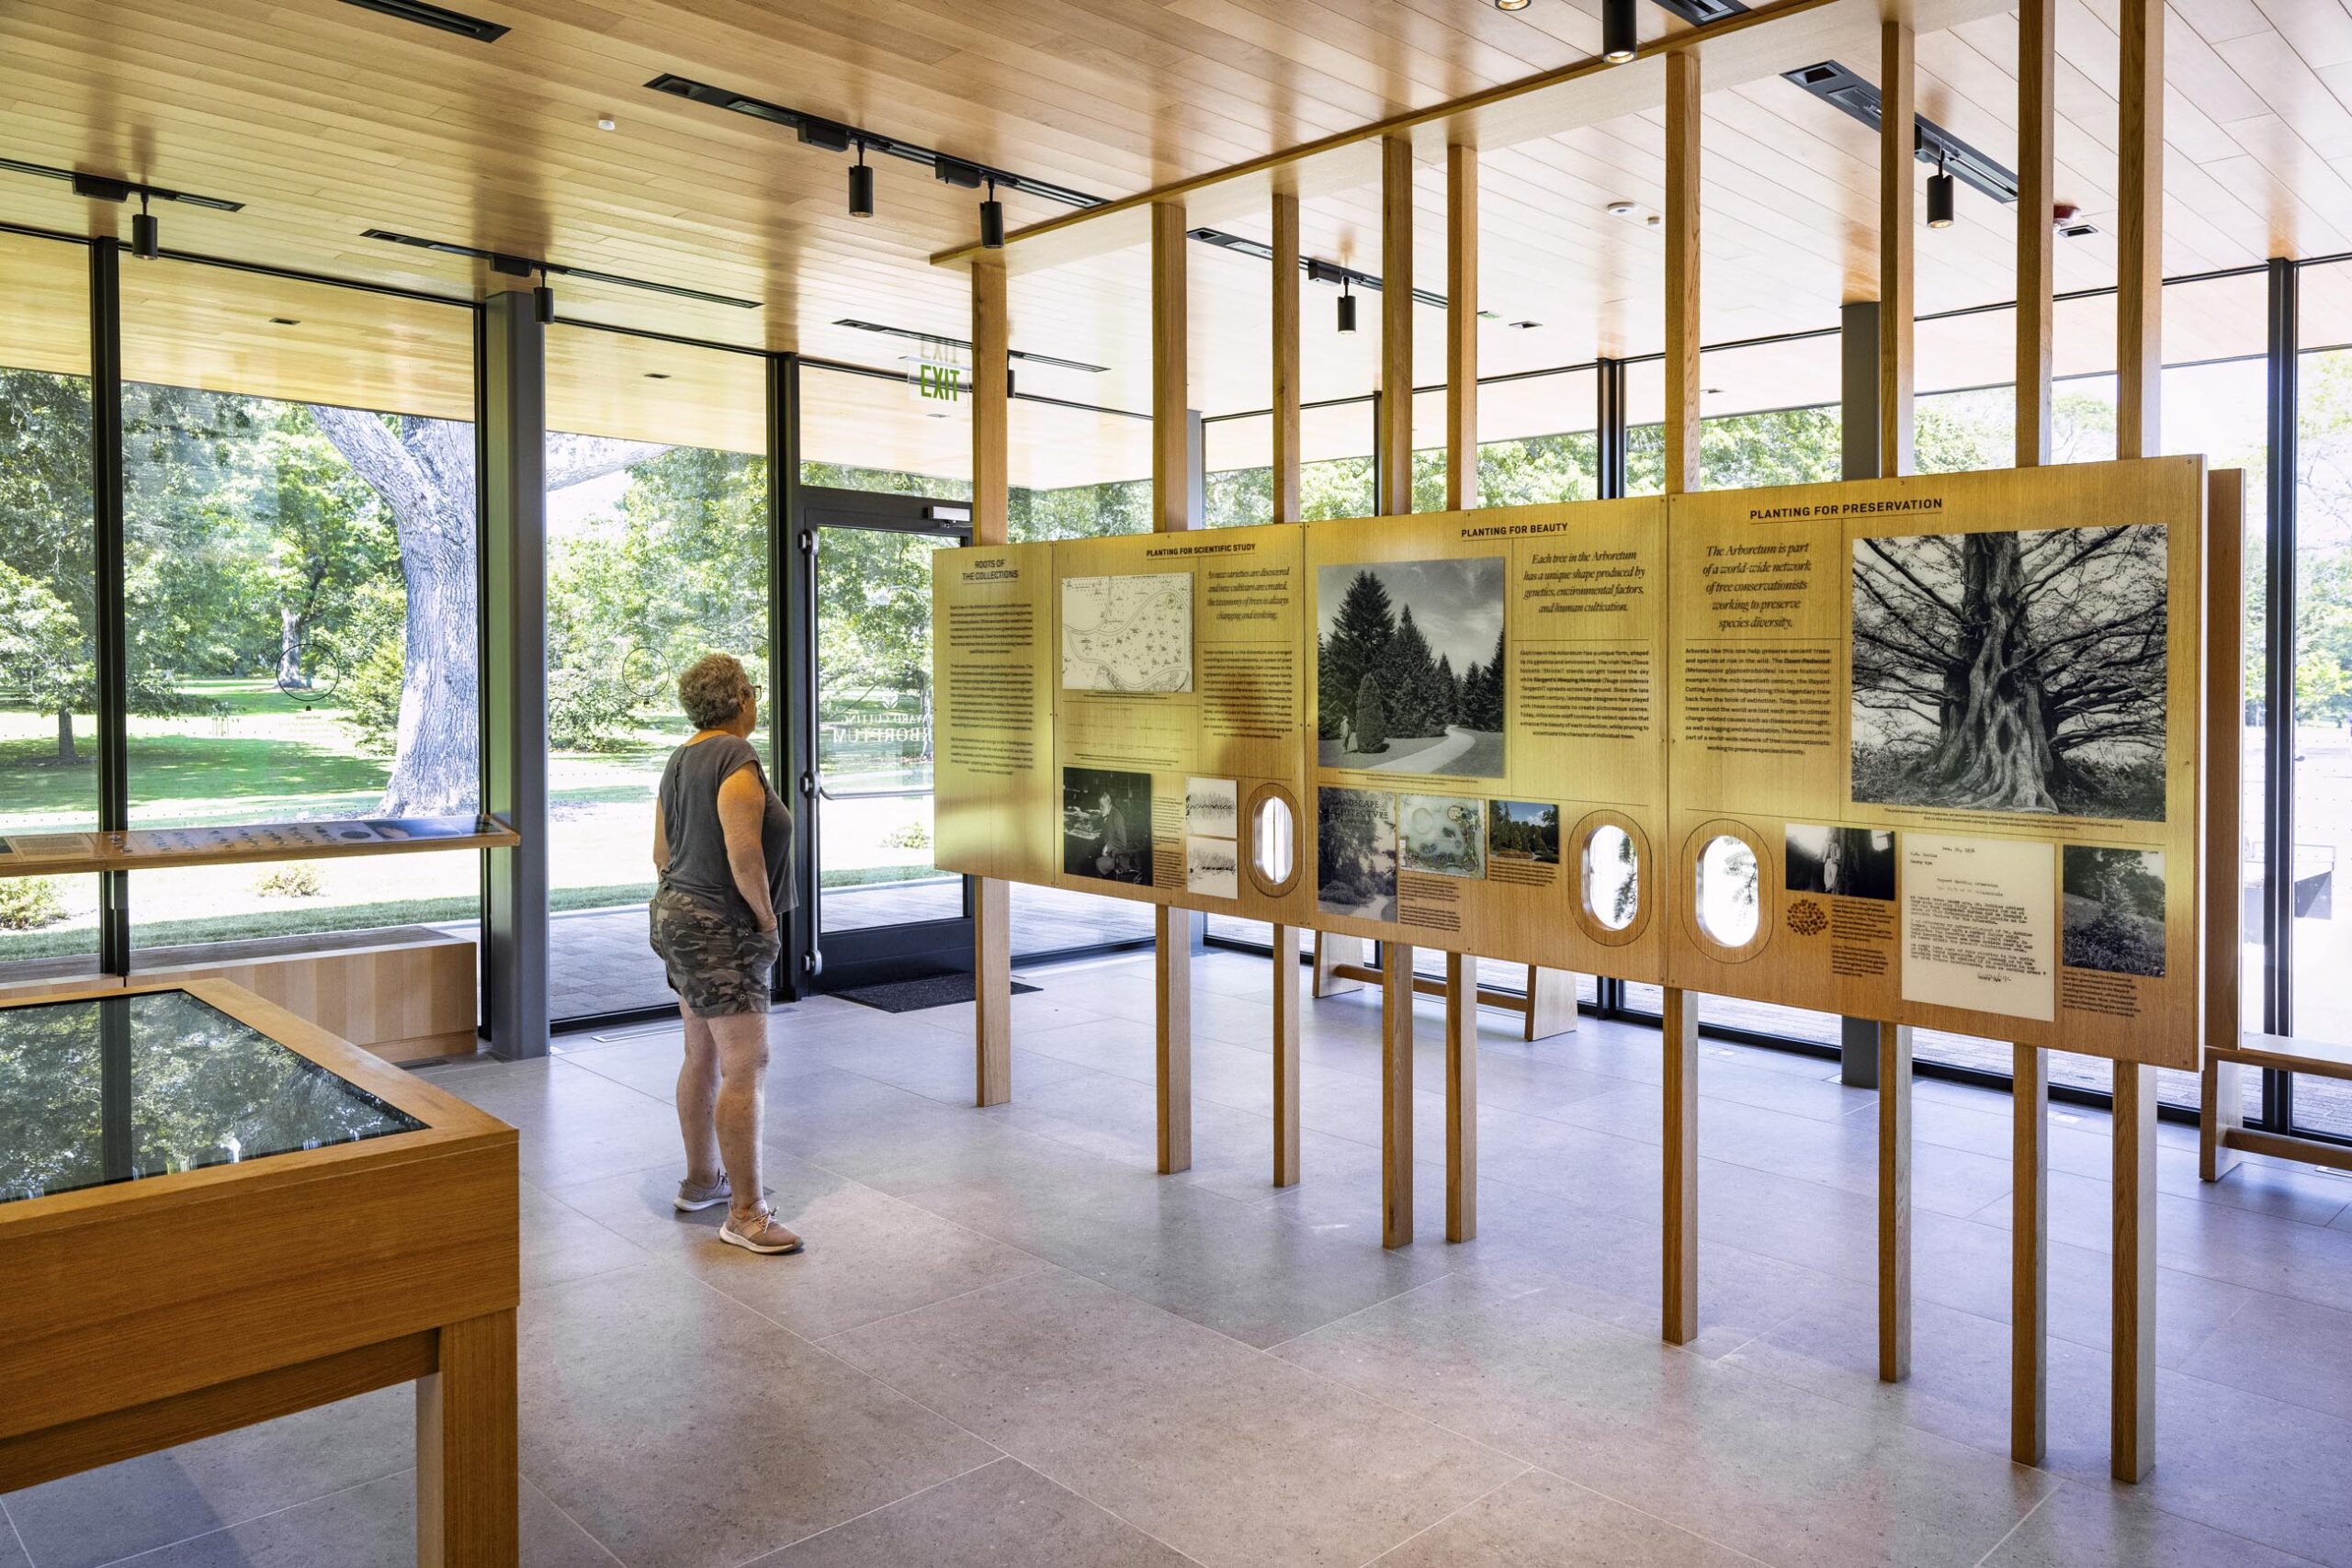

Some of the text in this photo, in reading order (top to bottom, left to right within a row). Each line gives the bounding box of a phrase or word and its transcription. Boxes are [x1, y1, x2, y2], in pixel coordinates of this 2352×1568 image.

[921, 364, 960, 401] EXIT
[1749, 498, 1943, 520] PLANTING FOR PRESERVATION
[1461, 523, 1569, 537] PLANTING FOR BEAUTY
[1193, 545, 1232, 554] SCIENTIFIC
[1232, 543, 1256, 551] STUDY
[1706, 542, 1809, 557] The Arboretum is part
[975, 558, 1005, 569] ROOTS OF
[1532, 551, 1636, 564] Each tree in the Arboretum
[1523, 570, 1537, 581] has
[1544, 570, 1571, 582] unique
[1571, 569, 1595, 582] shape
[1594, 567, 1635, 582] produced
[1635, 566, 1645, 579] by
[1702, 562, 1714, 577] of
[1720, 561, 1770, 574] world-wide
[1771, 559, 1812, 572] network
[962, 570, 1019, 581] THE COLLECTIONS
[1555, 584, 1614, 596] environmental
[1705, 580, 1808, 594] of tree conservationists
[1538, 603, 1555, 613] and
[1554, 603, 1583, 613] human
[1712, 599, 1802, 613] working to preserve
[1718, 617, 1749, 631] species
